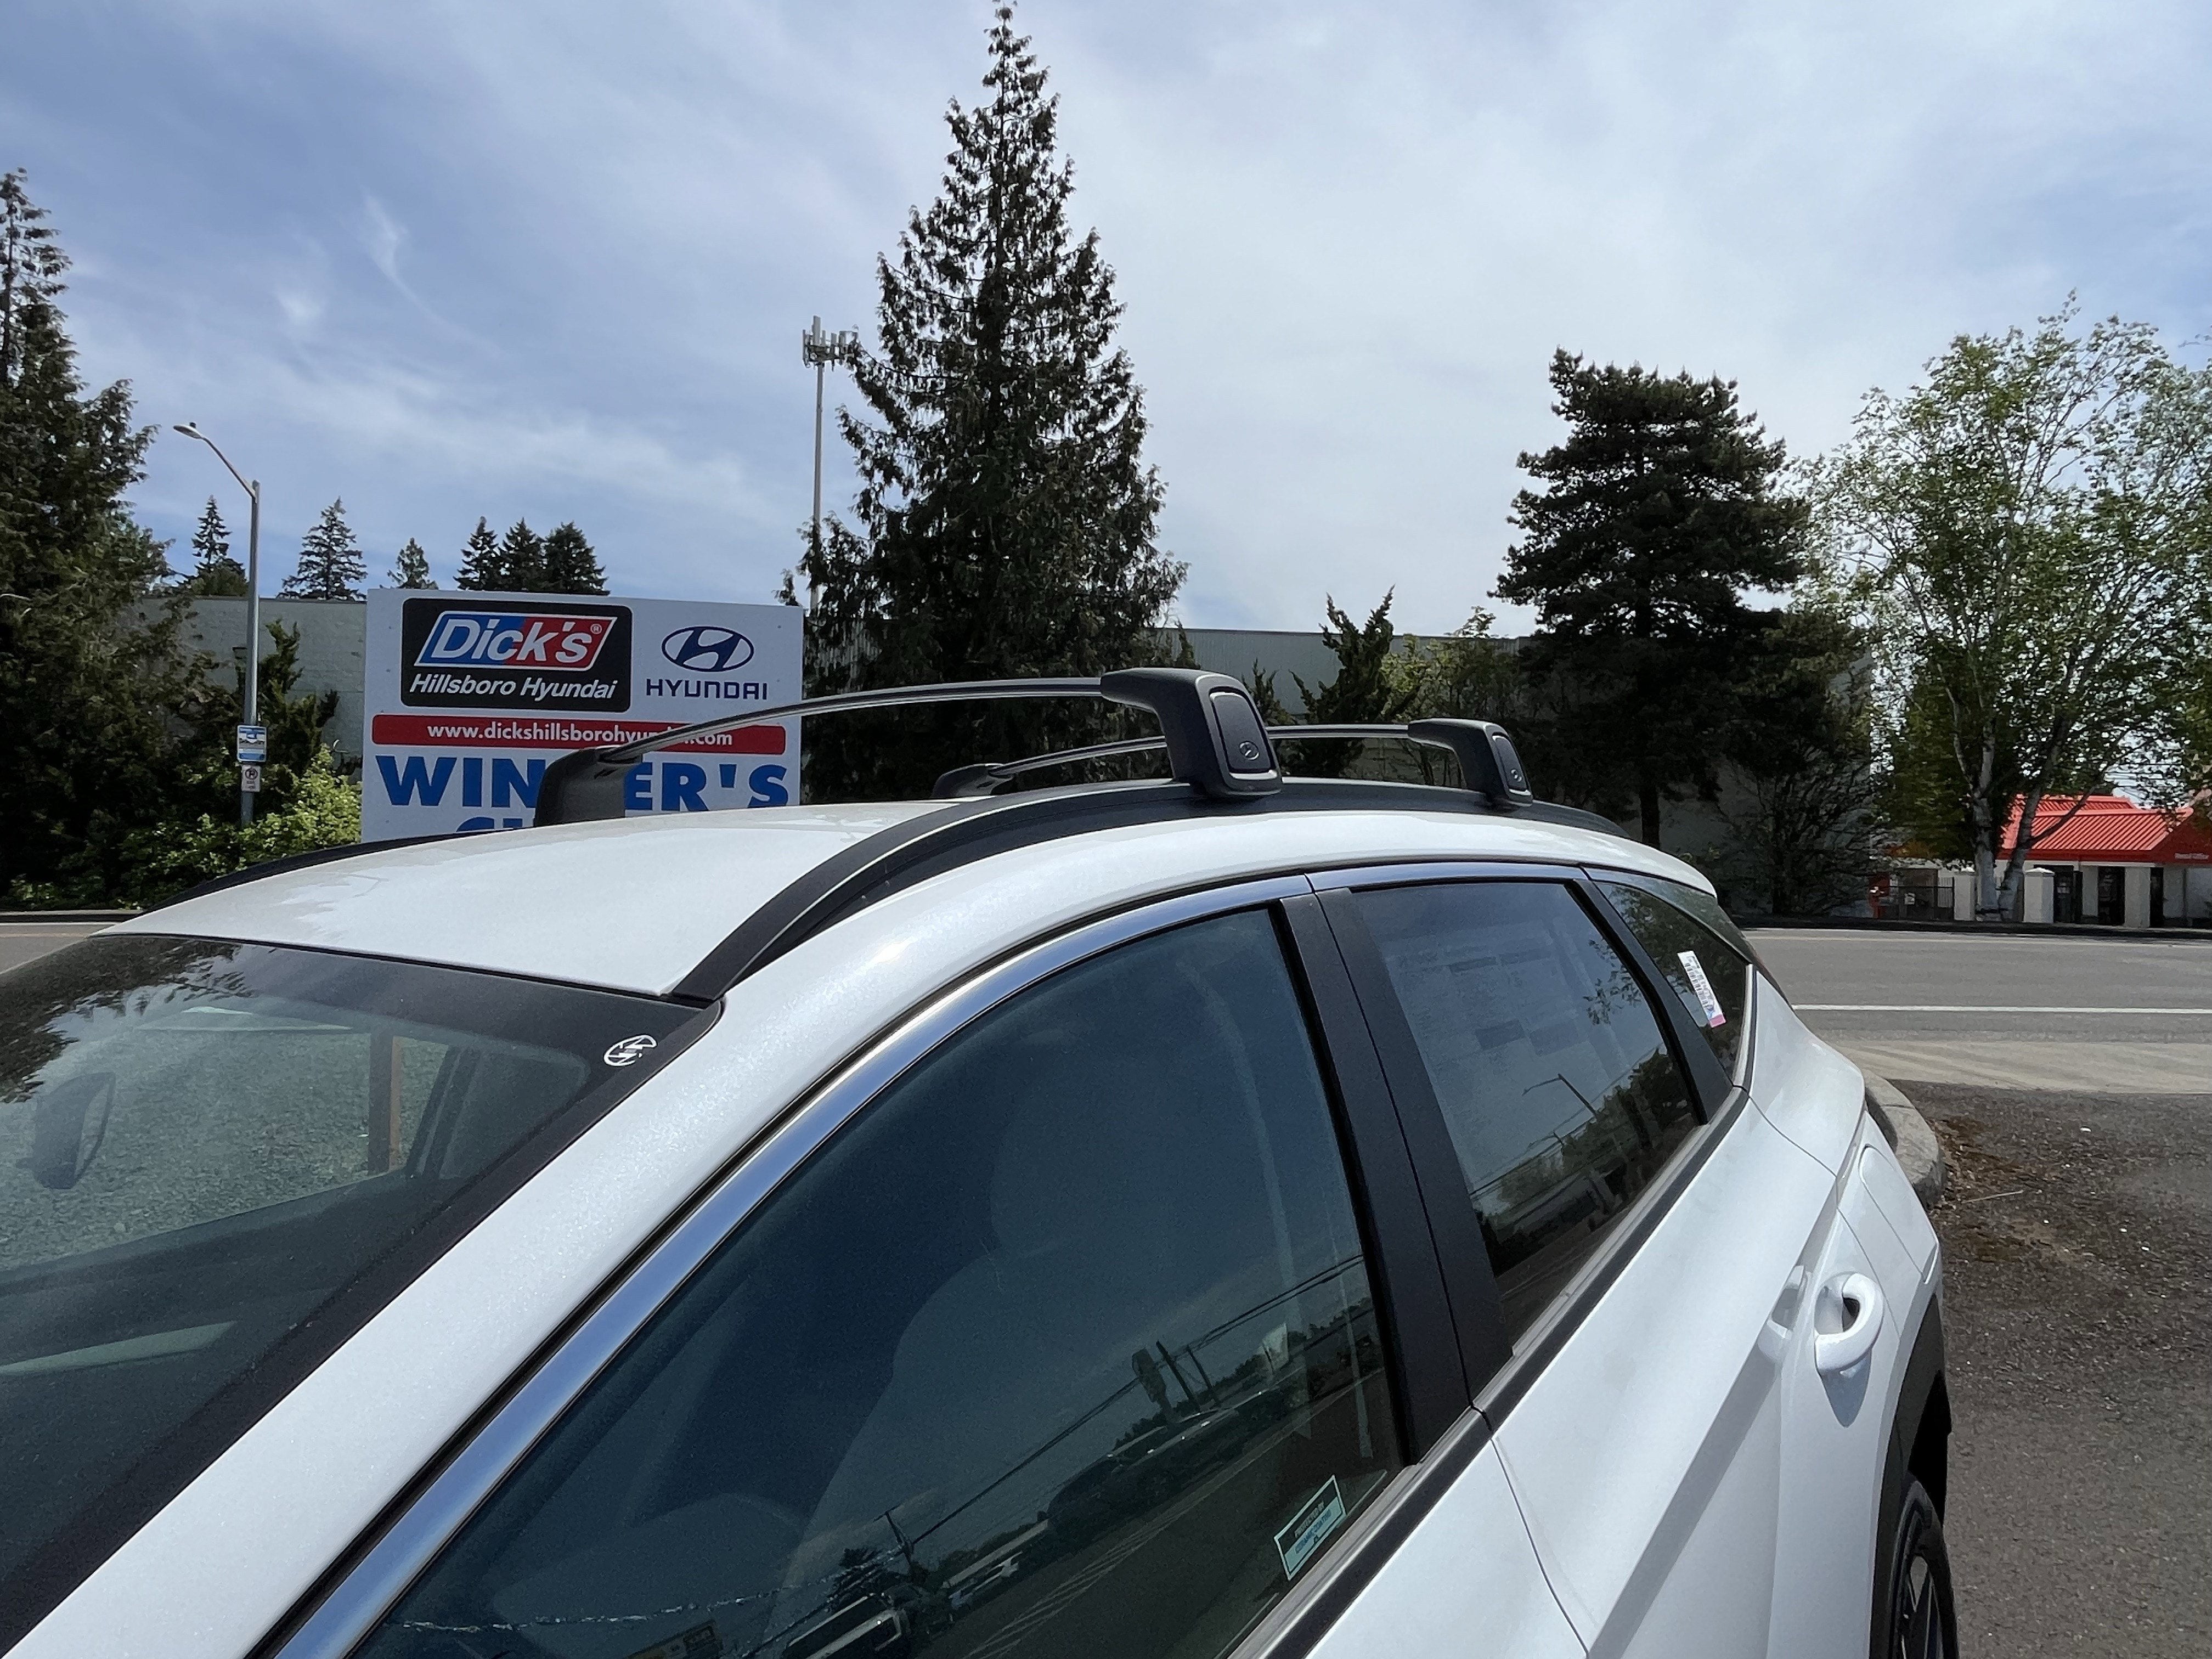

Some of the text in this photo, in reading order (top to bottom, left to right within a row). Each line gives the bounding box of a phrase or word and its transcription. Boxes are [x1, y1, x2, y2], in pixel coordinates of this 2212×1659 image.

[431, 618, 592, 663] Dick's
[410, 674, 618, 702] Hillsboro Hyundai
[646, 679, 767, 700] HYUNDAI
[427, 721, 733, 745] www.dickshillsborohyu.com
[375, 755, 789, 811] WINER'S
